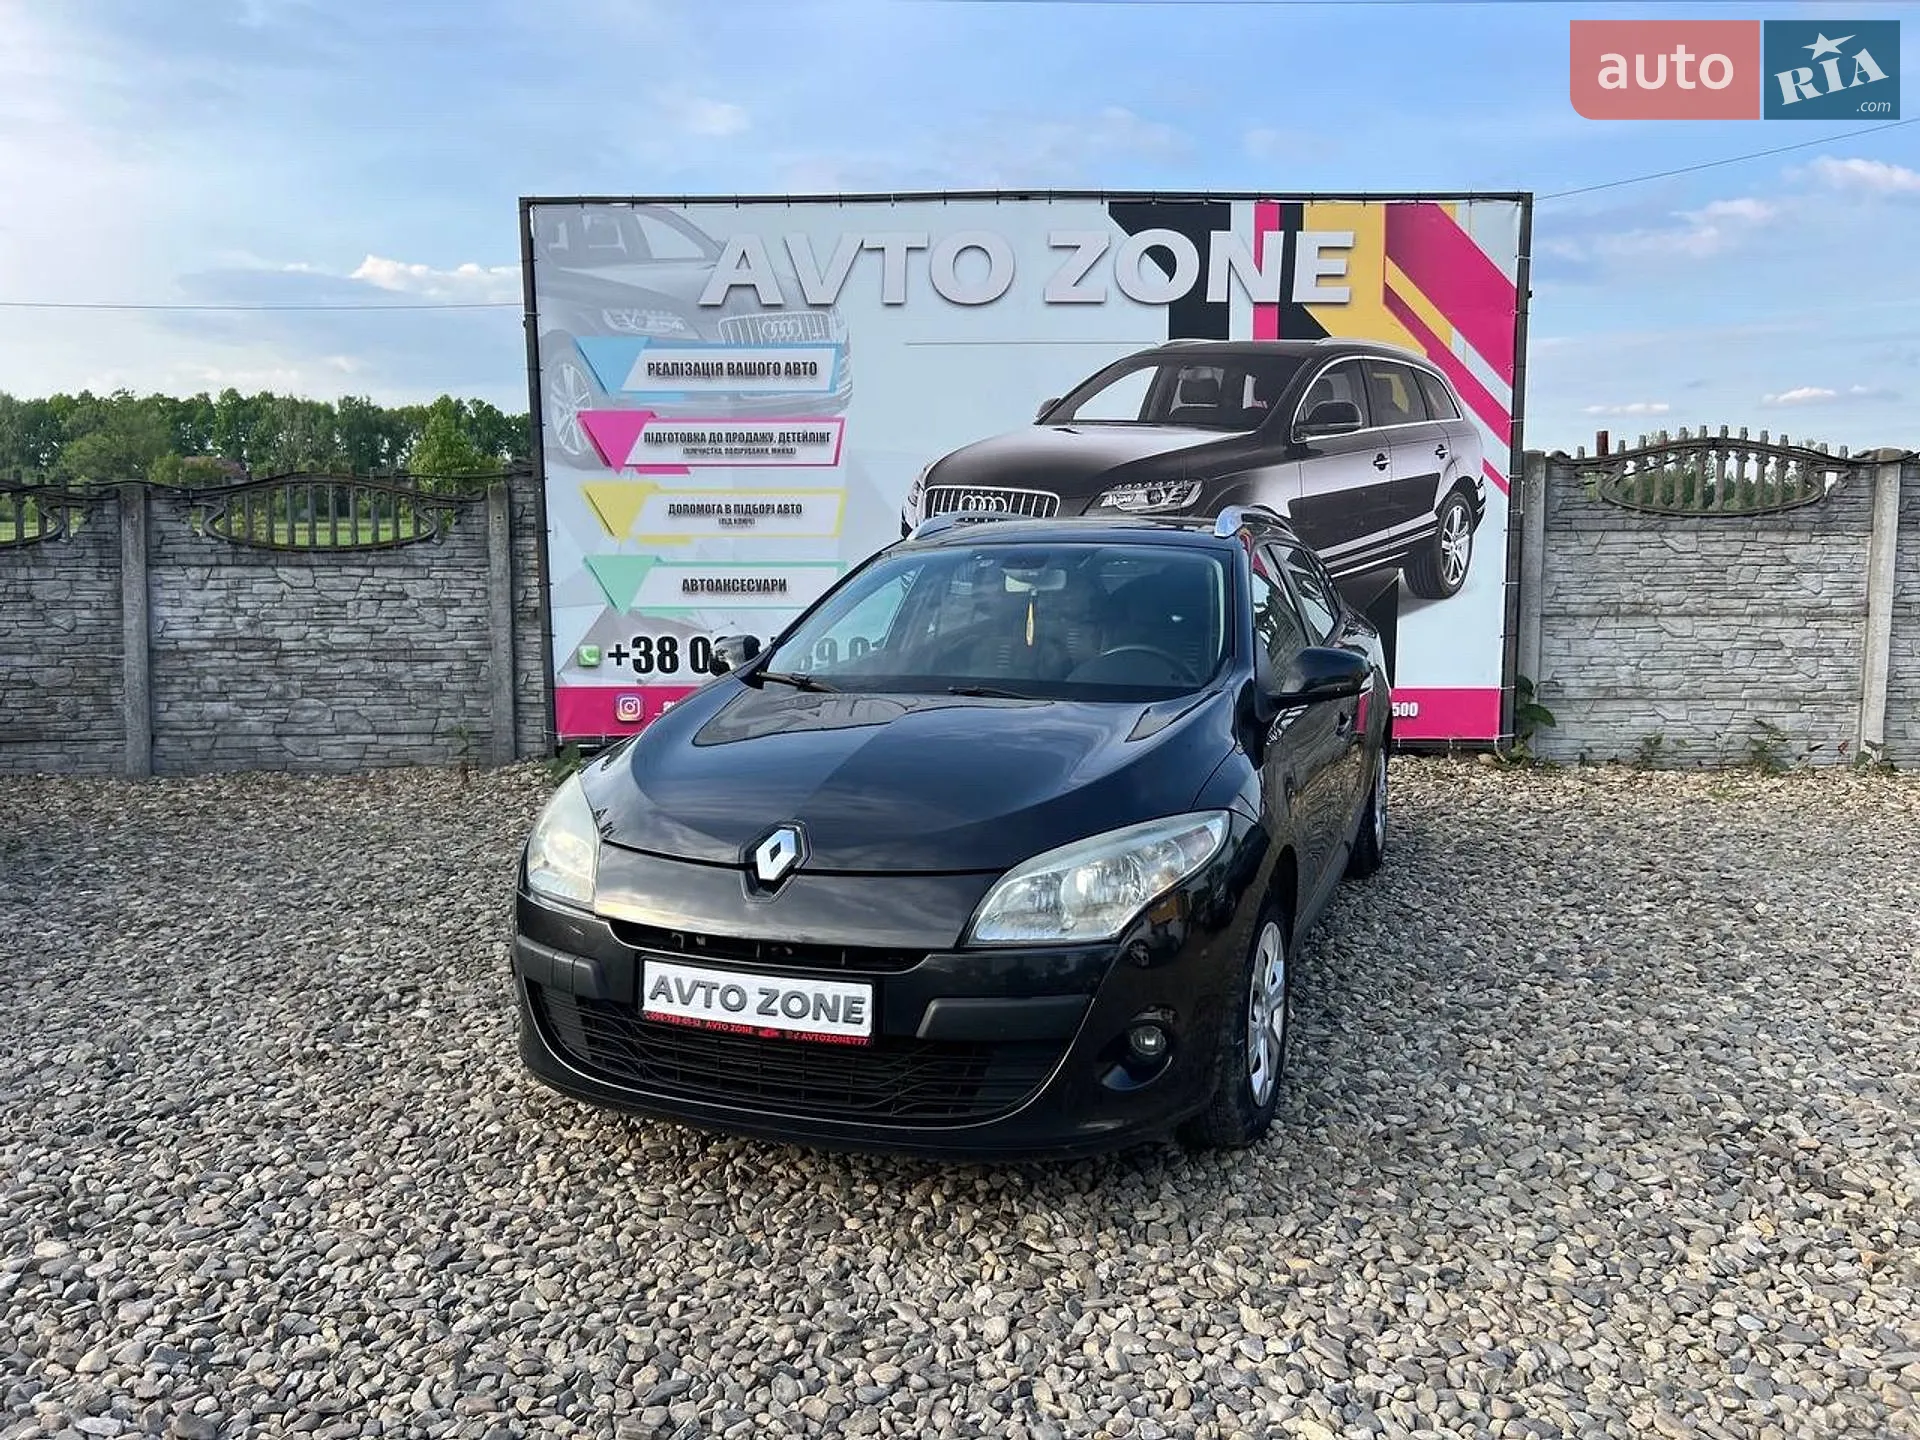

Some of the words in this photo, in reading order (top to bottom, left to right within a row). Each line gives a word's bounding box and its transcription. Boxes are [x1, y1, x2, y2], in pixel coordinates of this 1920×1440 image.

[697, 228, 1016, 306] AVTO
[1044, 228, 1355, 305] ZONE
[647, 361, 724, 378] РЕАЛІЗАЦІЯ
[727, 361, 782, 377] ВАШОГО
[784, 361, 818, 377] АВТО
[643, 431, 707, 445] ПІДГОТОВКА
[708, 431, 723, 444] ДО
[778, 430, 832, 444] ДЕТЕЙЛІНГ
[668, 503, 723, 516] ДОПОМОГА
[724, 503, 732, 514] В
[733, 503, 775, 515] ПІДБОРІ
[776, 503, 803, 514] АВТО
[682, 578, 787, 593] АВТОАКСЕСУАРИ
[607, 635, 679, 675] +38
[649, 974, 748, 1013] AVTO
[756, 986, 866, 1026] ZONE
